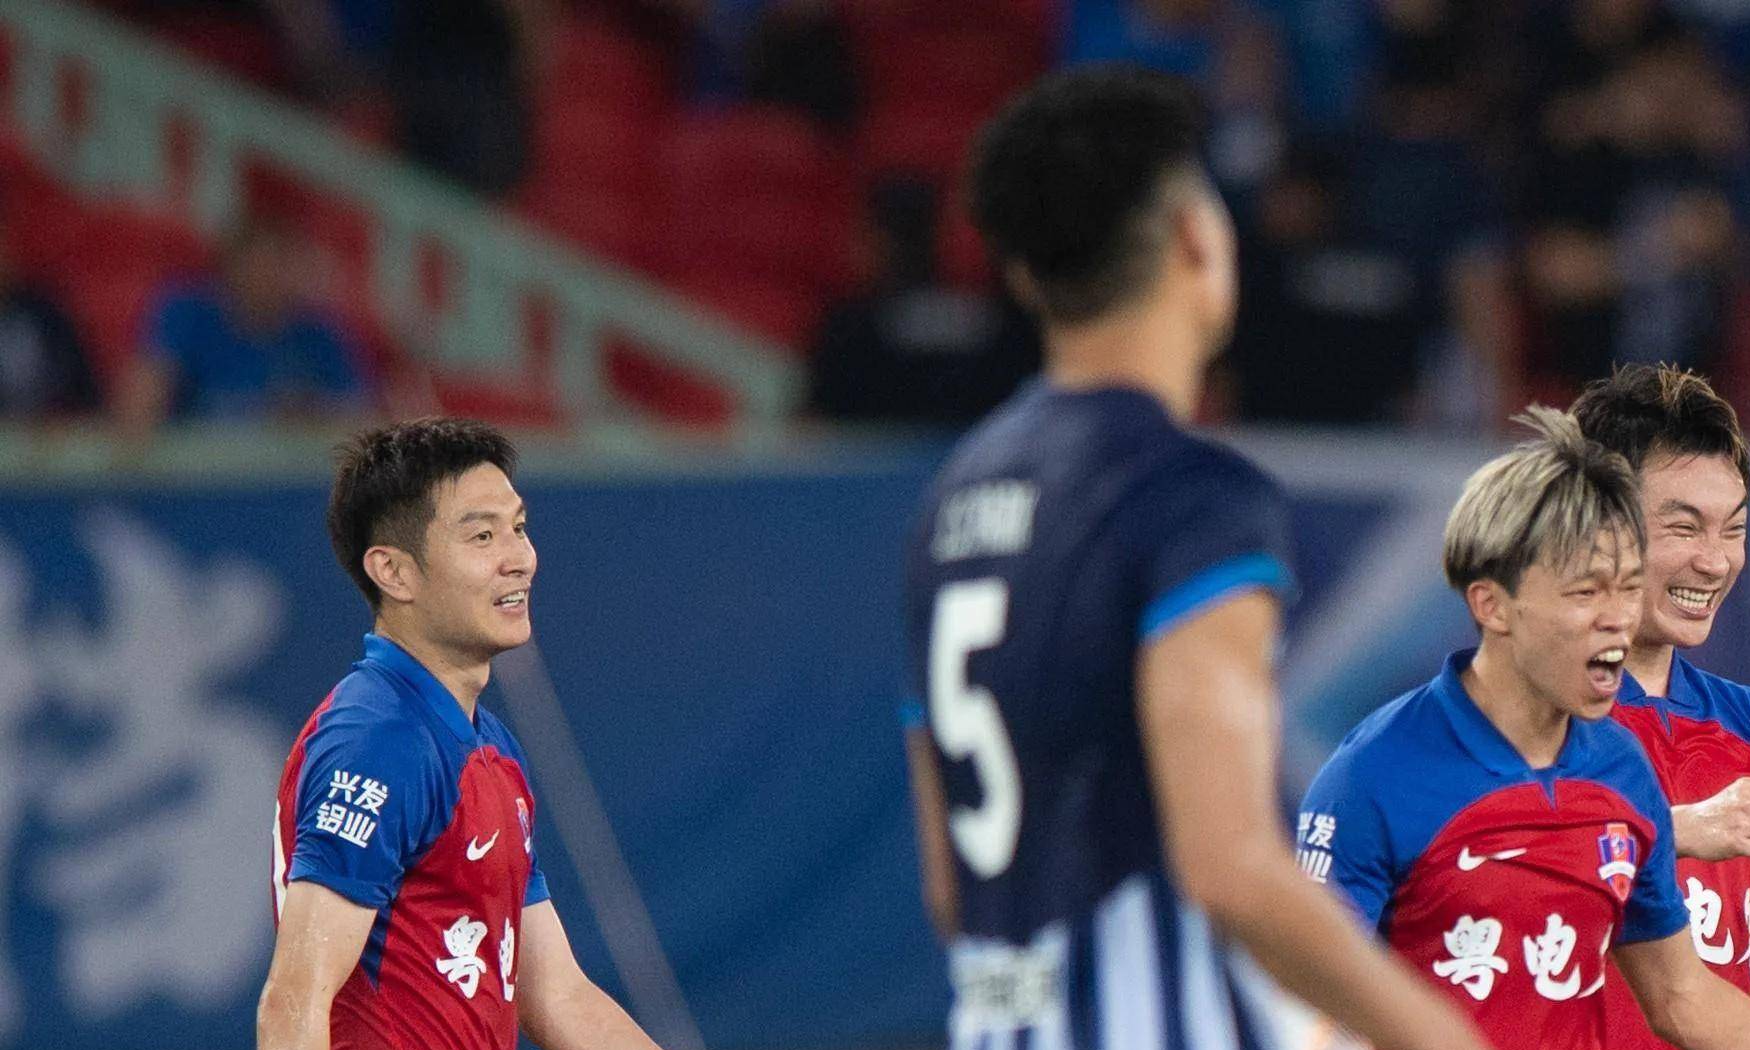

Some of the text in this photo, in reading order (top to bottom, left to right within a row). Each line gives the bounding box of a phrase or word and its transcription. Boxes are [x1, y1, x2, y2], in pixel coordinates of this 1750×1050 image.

[928, 576, 1022, 879] 5
[328, 770, 389, 816] 兴发
[315, 801, 377, 848] 铝业
